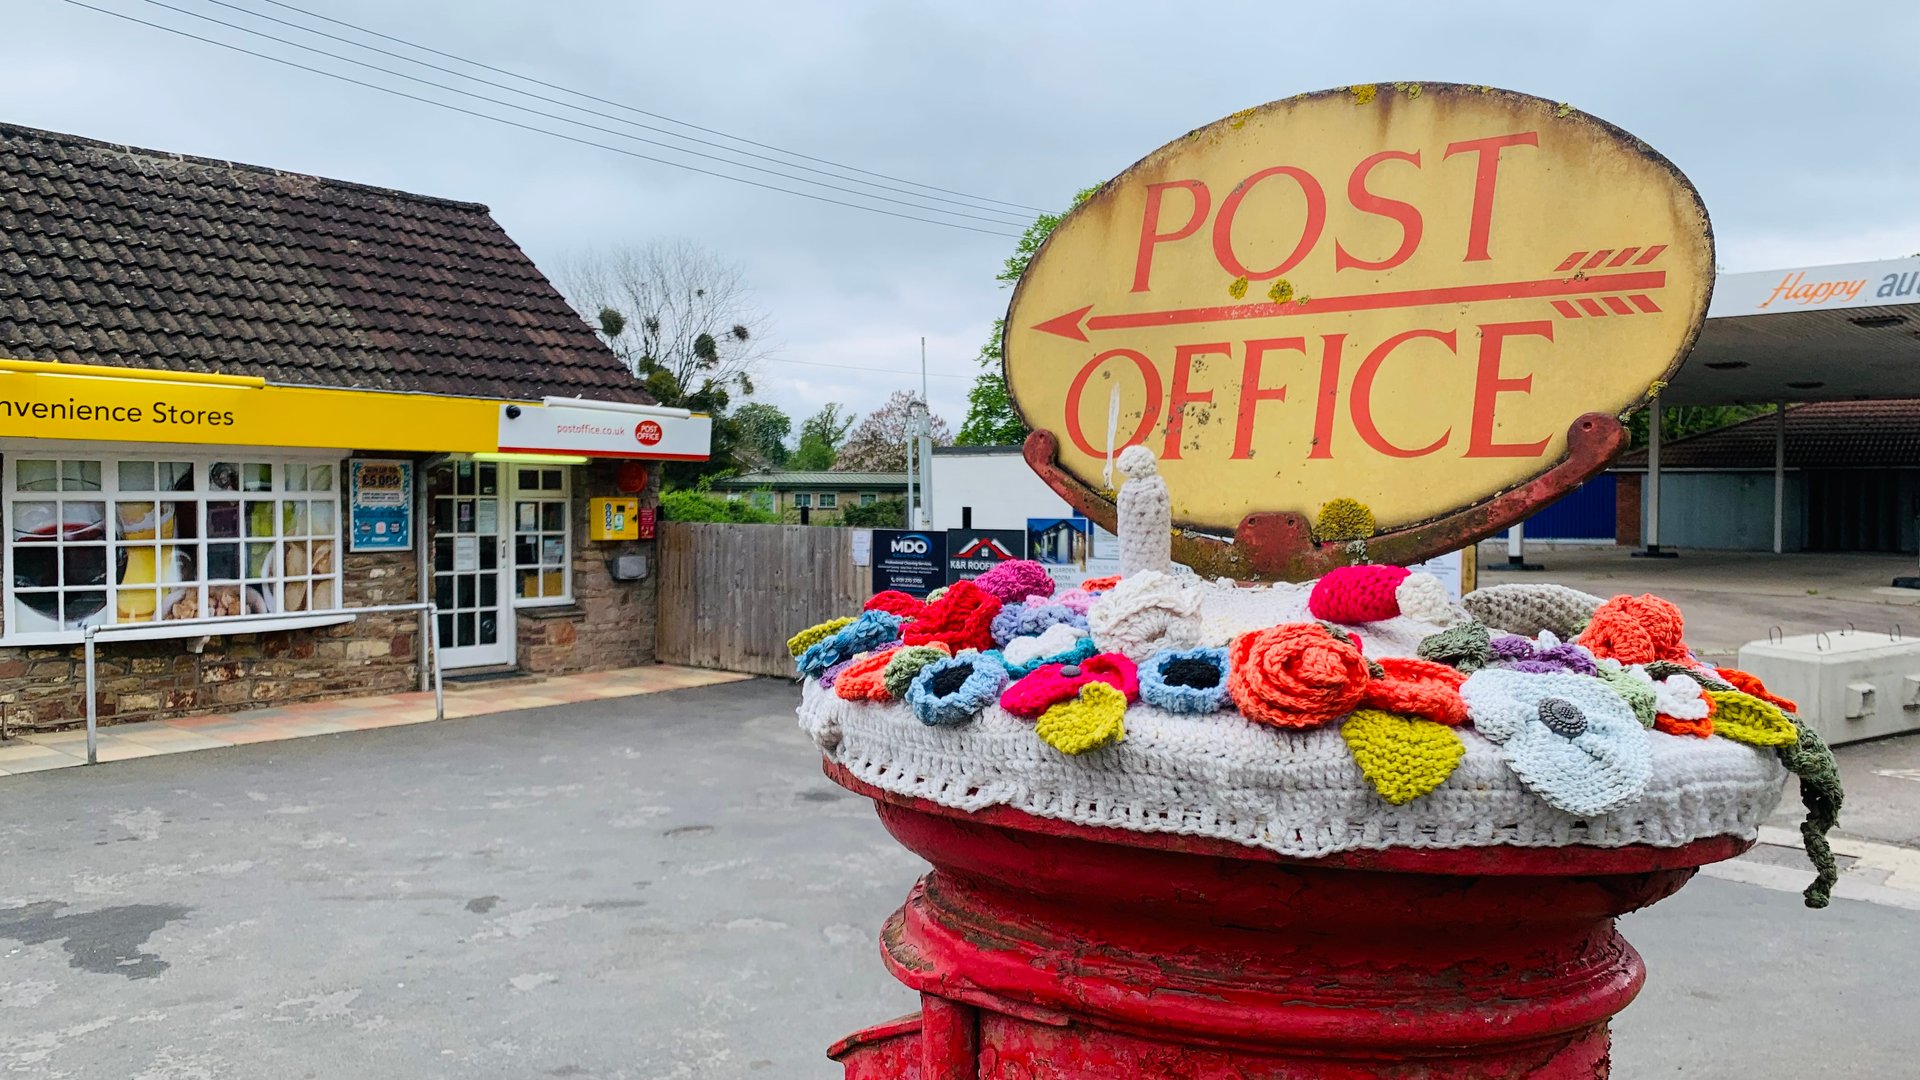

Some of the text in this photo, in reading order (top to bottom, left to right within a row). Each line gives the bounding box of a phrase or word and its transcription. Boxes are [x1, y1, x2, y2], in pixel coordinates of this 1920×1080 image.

[1128, 131, 1540, 294] POST
[1756, 270, 1920, 309] Happy au
[1064, 319, 1556, 460] OFFICE
[152, 401, 235, 426] Stores
[557, 424, 625, 436] postoffice.co.uk
[641, 424, 658, 433] POST
[636, 432, 660, 441] OFFICE
[890, 540, 928, 554] MDO
[949, 560, 967, 570] K&R
